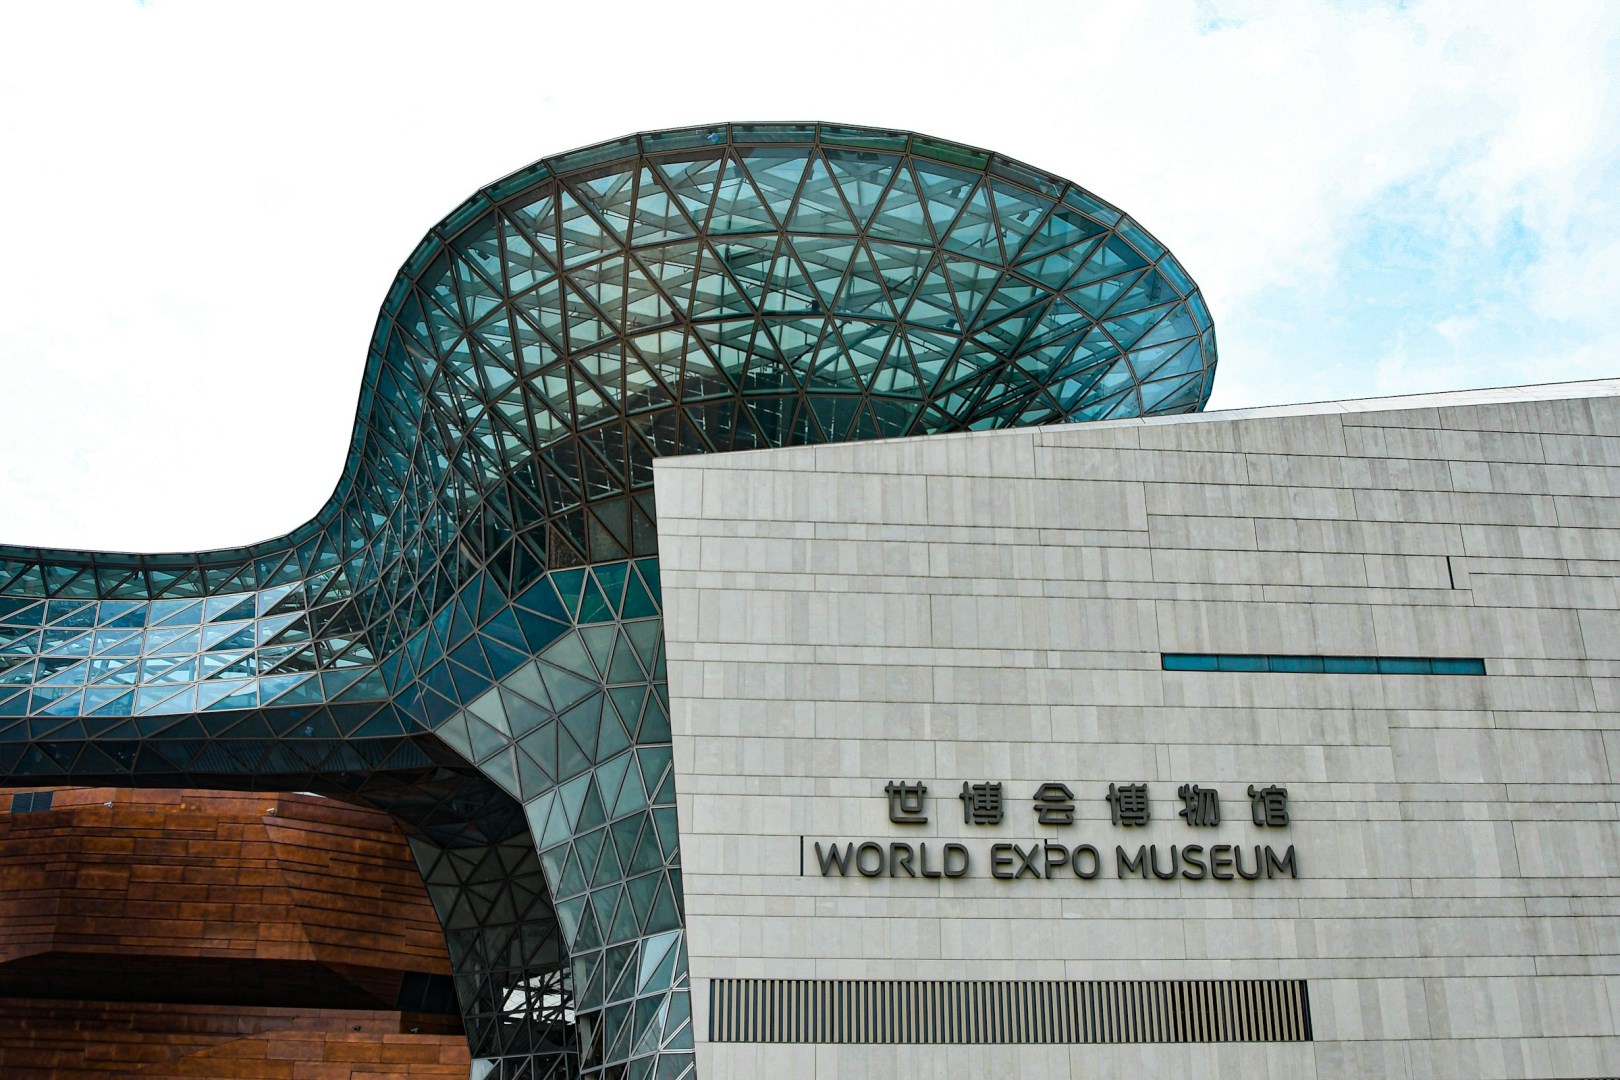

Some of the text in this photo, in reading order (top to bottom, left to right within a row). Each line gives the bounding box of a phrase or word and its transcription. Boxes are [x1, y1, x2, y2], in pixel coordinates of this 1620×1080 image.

[885, 781, 1290, 828] 世博会博物馆
[814, 842, 1298, 881] WORLD EXPO MUSEUM
